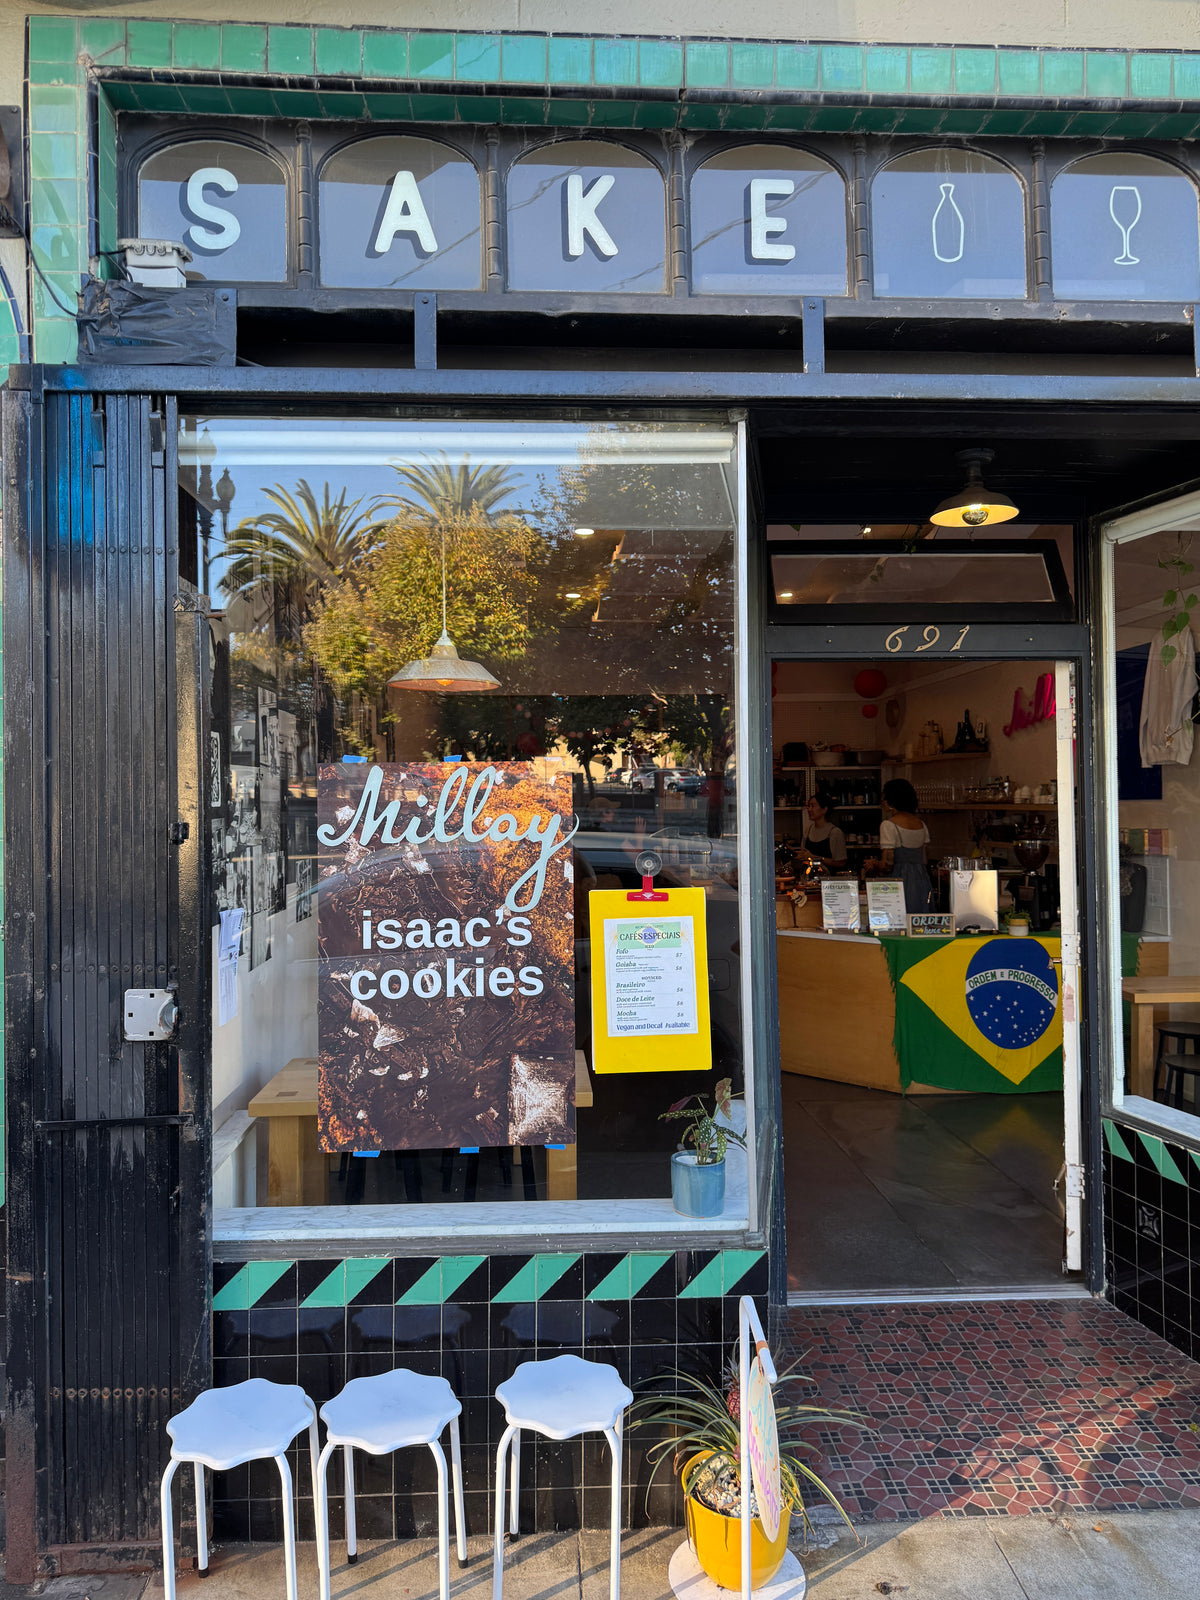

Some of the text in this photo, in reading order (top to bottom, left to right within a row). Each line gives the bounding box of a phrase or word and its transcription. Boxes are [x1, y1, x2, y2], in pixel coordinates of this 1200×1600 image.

[186, 167, 796, 260] SAKE
[885, 625, 969, 653] 691
[317, 765, 579, 913] Millay
[362, 909, 533, 950] isaac's
[912, 916, 949, 925] ORDER
[923, 927, 941, 935] here
[620, 931, 681, 941] CAFÉS ESPECIAIS
[350, 957, 544, 1000] cookies
[968, 971, 997, 989] ORDEM
[1008, 970, 1056, 1001] PROGRESSO
[616, 1024, 634, 1032] Vegan
